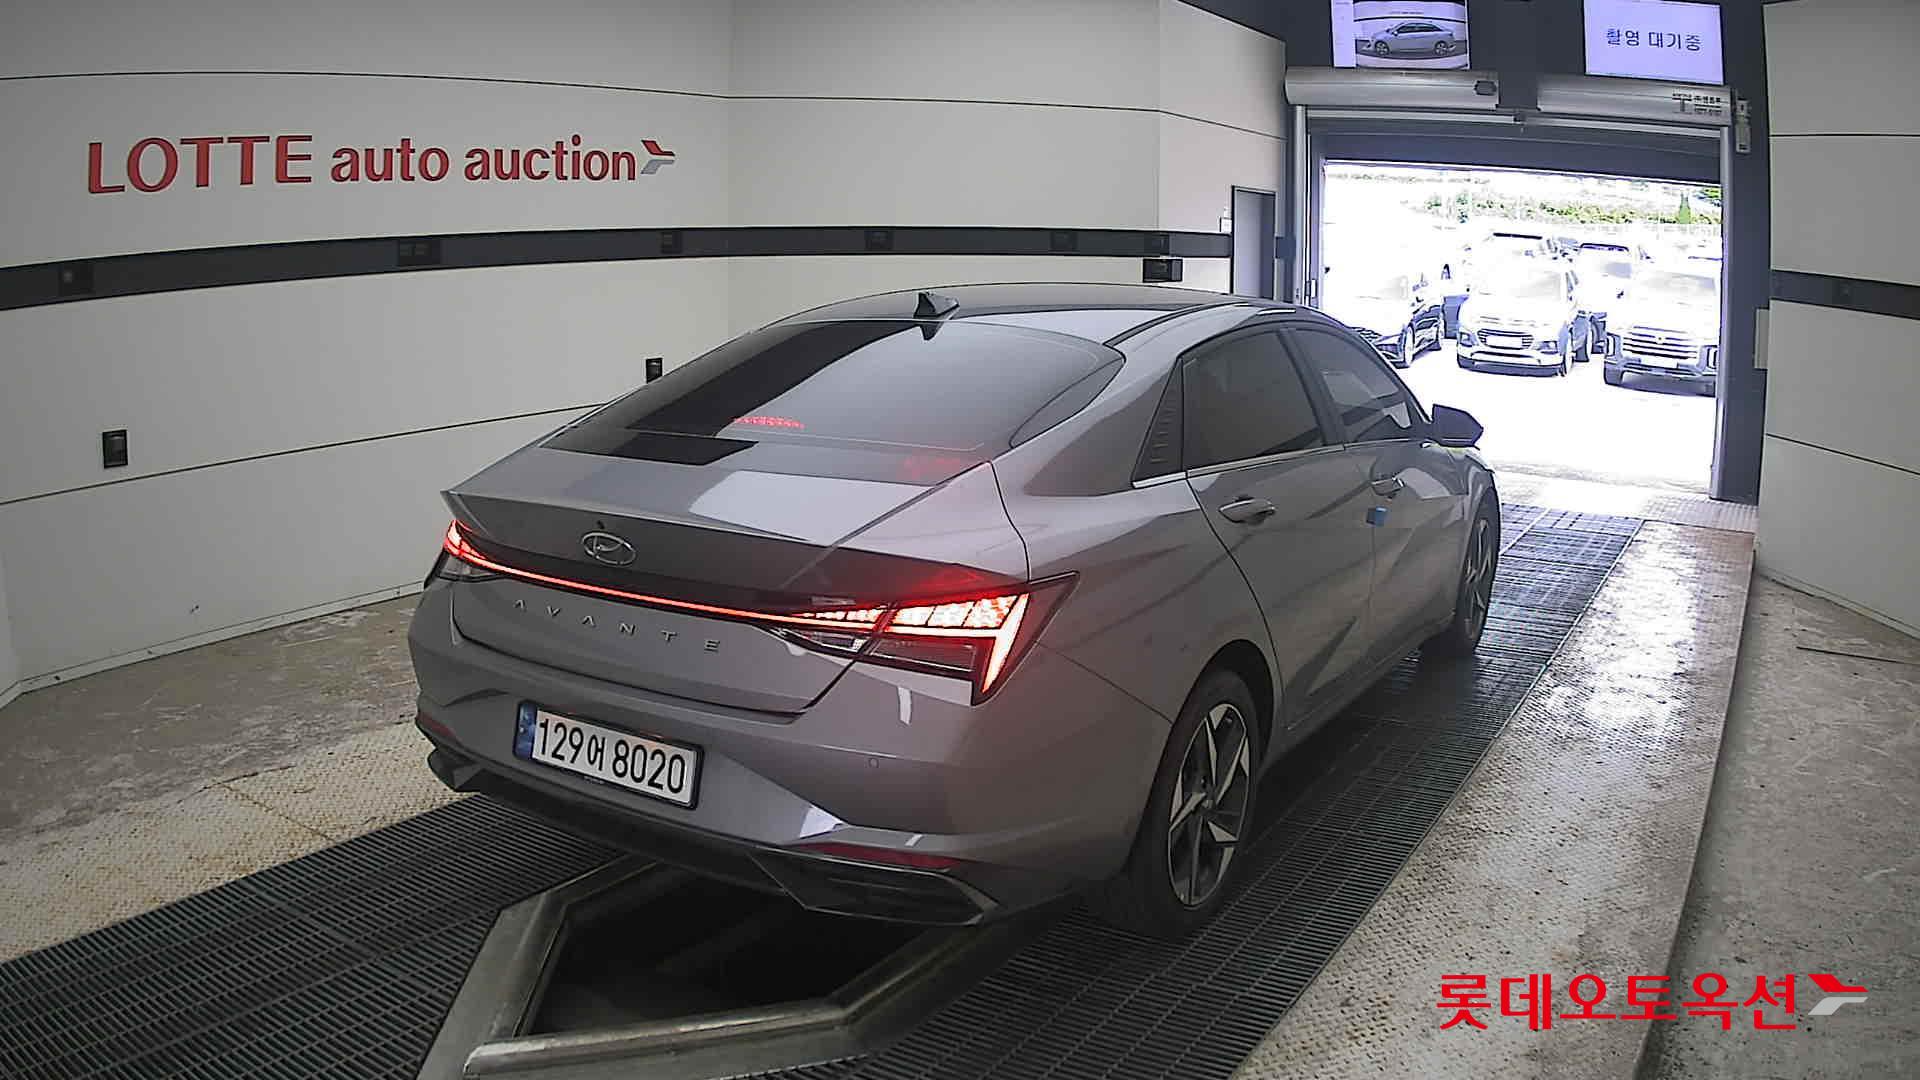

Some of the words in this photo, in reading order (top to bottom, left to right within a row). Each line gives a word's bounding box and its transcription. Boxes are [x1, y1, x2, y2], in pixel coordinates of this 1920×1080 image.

[1607, 28, 1640, 46] 촬영
[1649, 32, 1701, 52] 대기중
[88, 135, 312, 194] LOTTE
[331, 138, 449, 182] auto
[464, 134, 637, 182] auction
[513, 599, 721, 653] AVANTE
